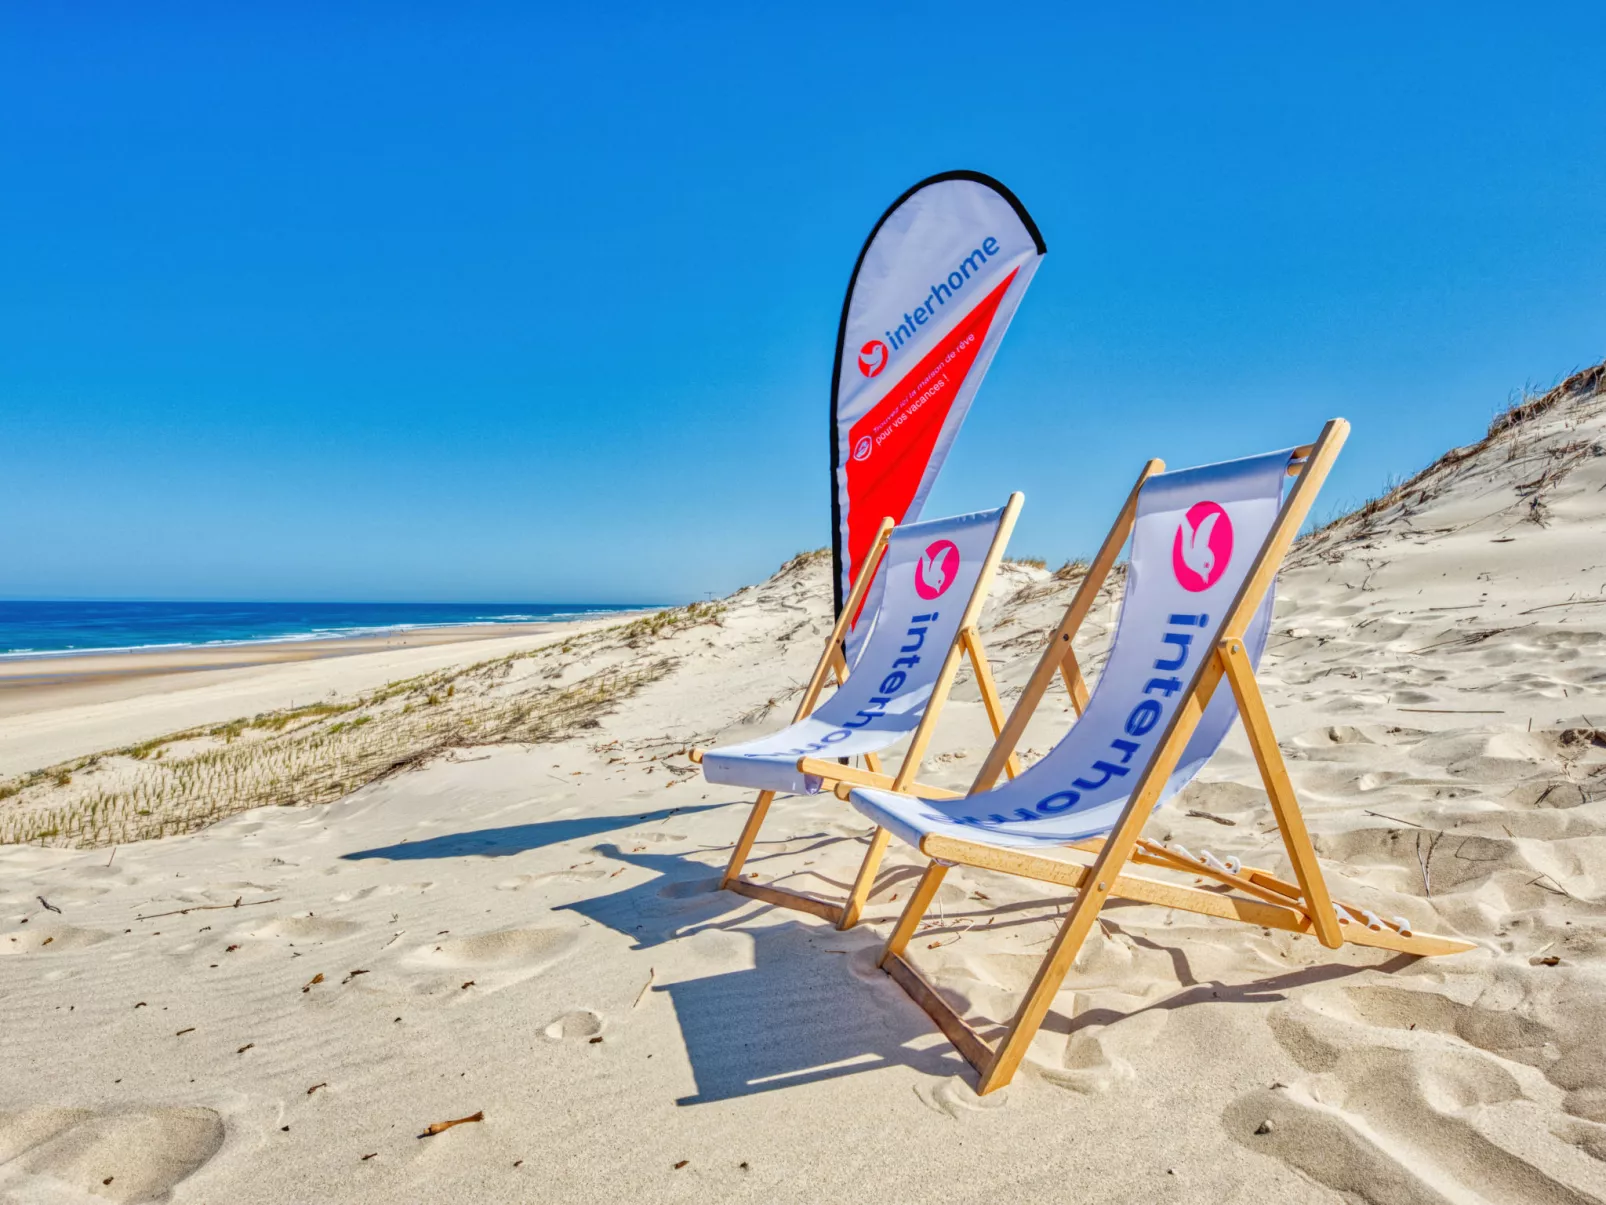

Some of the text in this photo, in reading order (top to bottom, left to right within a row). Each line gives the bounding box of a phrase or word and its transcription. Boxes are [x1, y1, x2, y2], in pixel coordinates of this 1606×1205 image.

[886, 237, 999, 350] interhome
[917, 362, 945, 390] maison
[945, 352, 956, 363] de
[957, 333, 975, 353] rêve
[876, 427, 893, 446] pour
[892, 413, 908, 428] vos
[907, 380, 945, 415] vacances
